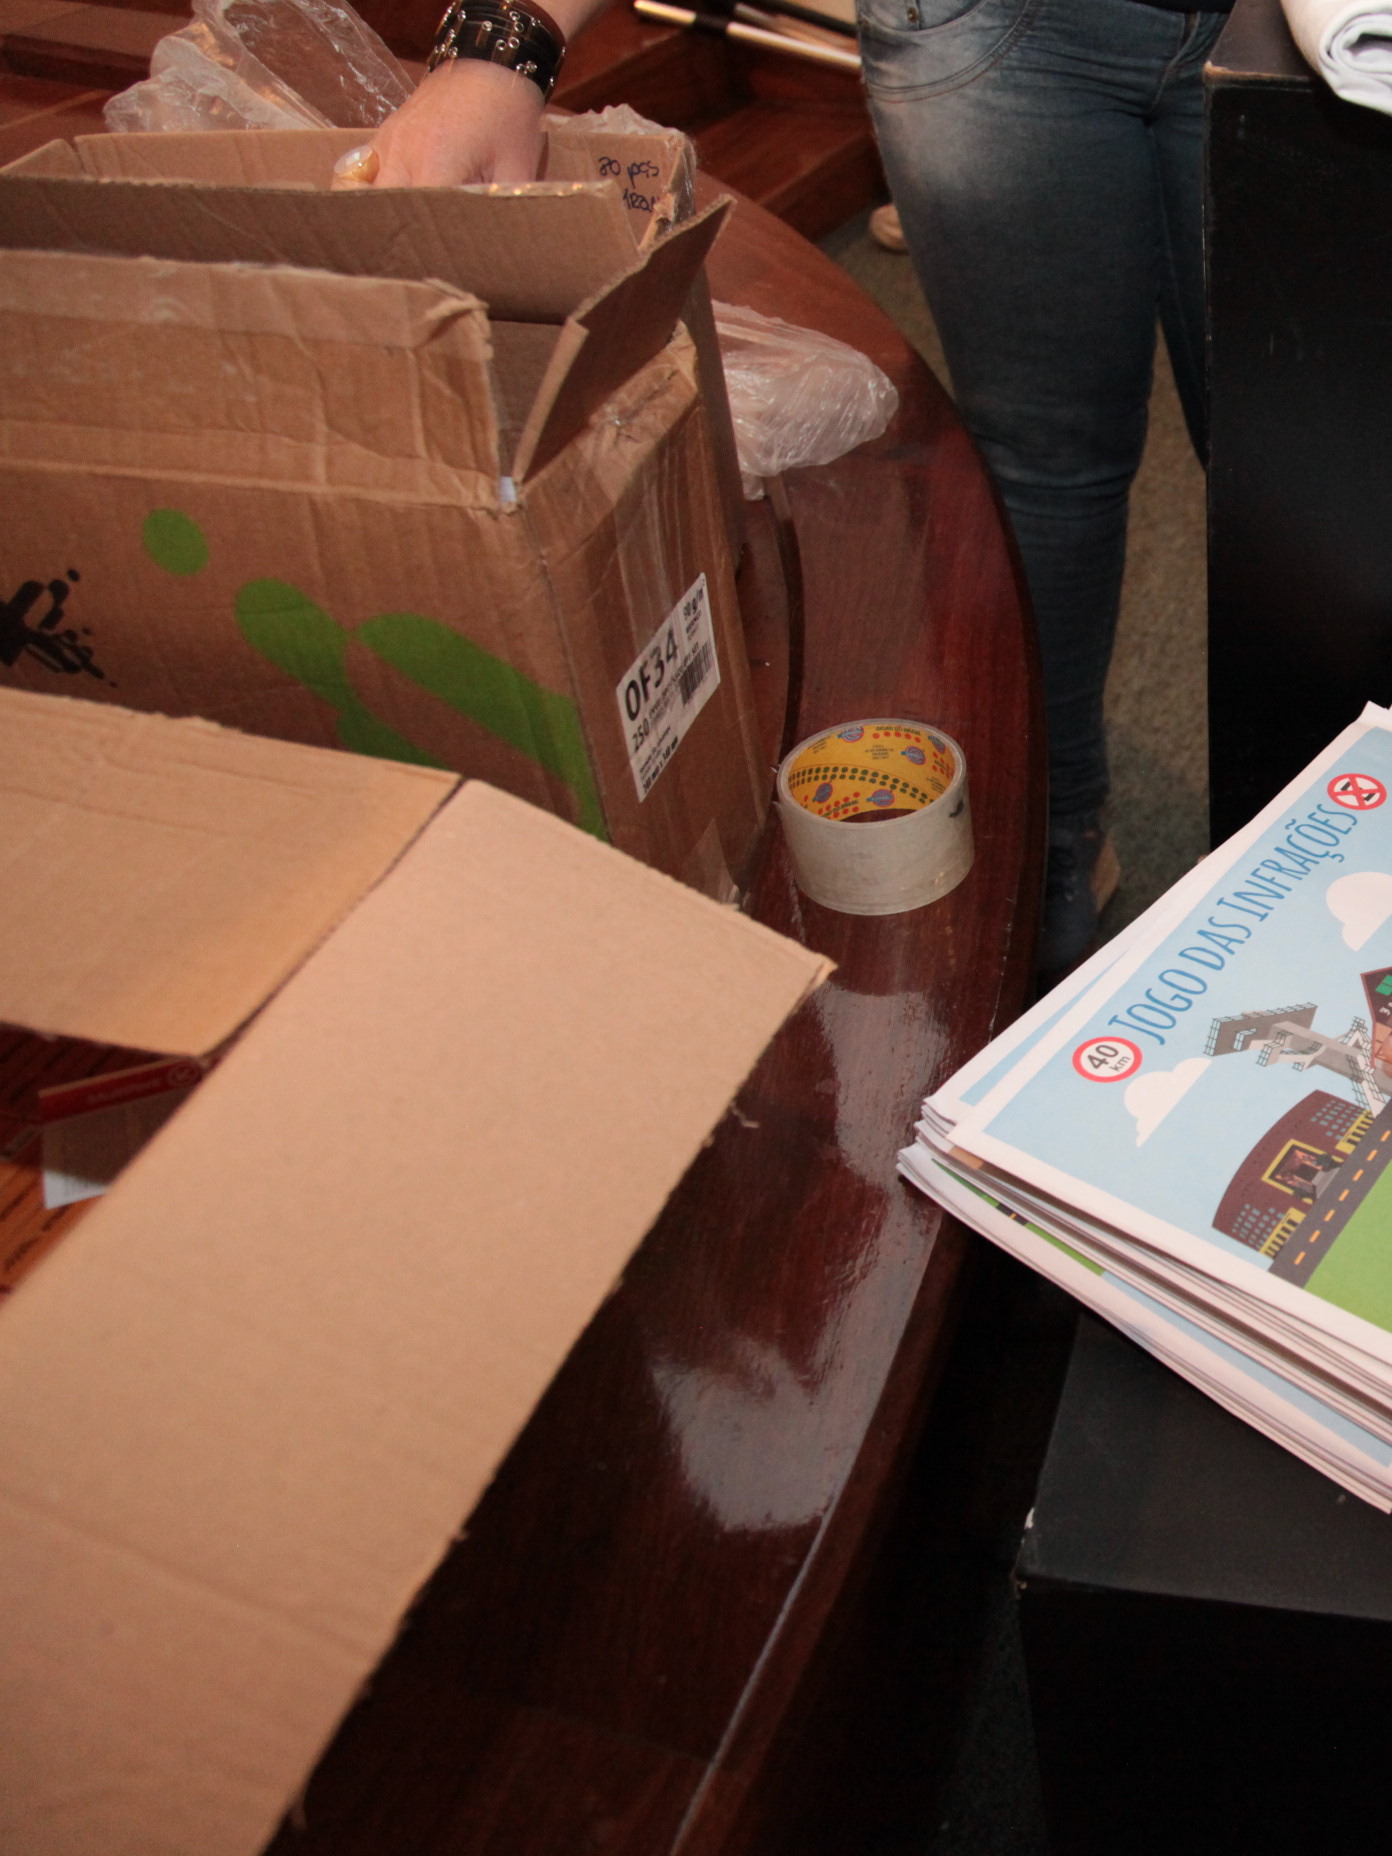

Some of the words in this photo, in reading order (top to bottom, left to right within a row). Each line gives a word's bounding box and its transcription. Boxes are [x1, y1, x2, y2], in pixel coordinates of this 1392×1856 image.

[625, 627, 678, 721] OF34
[1107, 968, 1208, 1045] JOGO
[1178, 915, 1252, 971] DAS
[1216, 803, 1358, 922] INFRAÇÕES
[1087, 1044, 1120, 1070] 40
[1109, 1055, 1132, 1072] km
